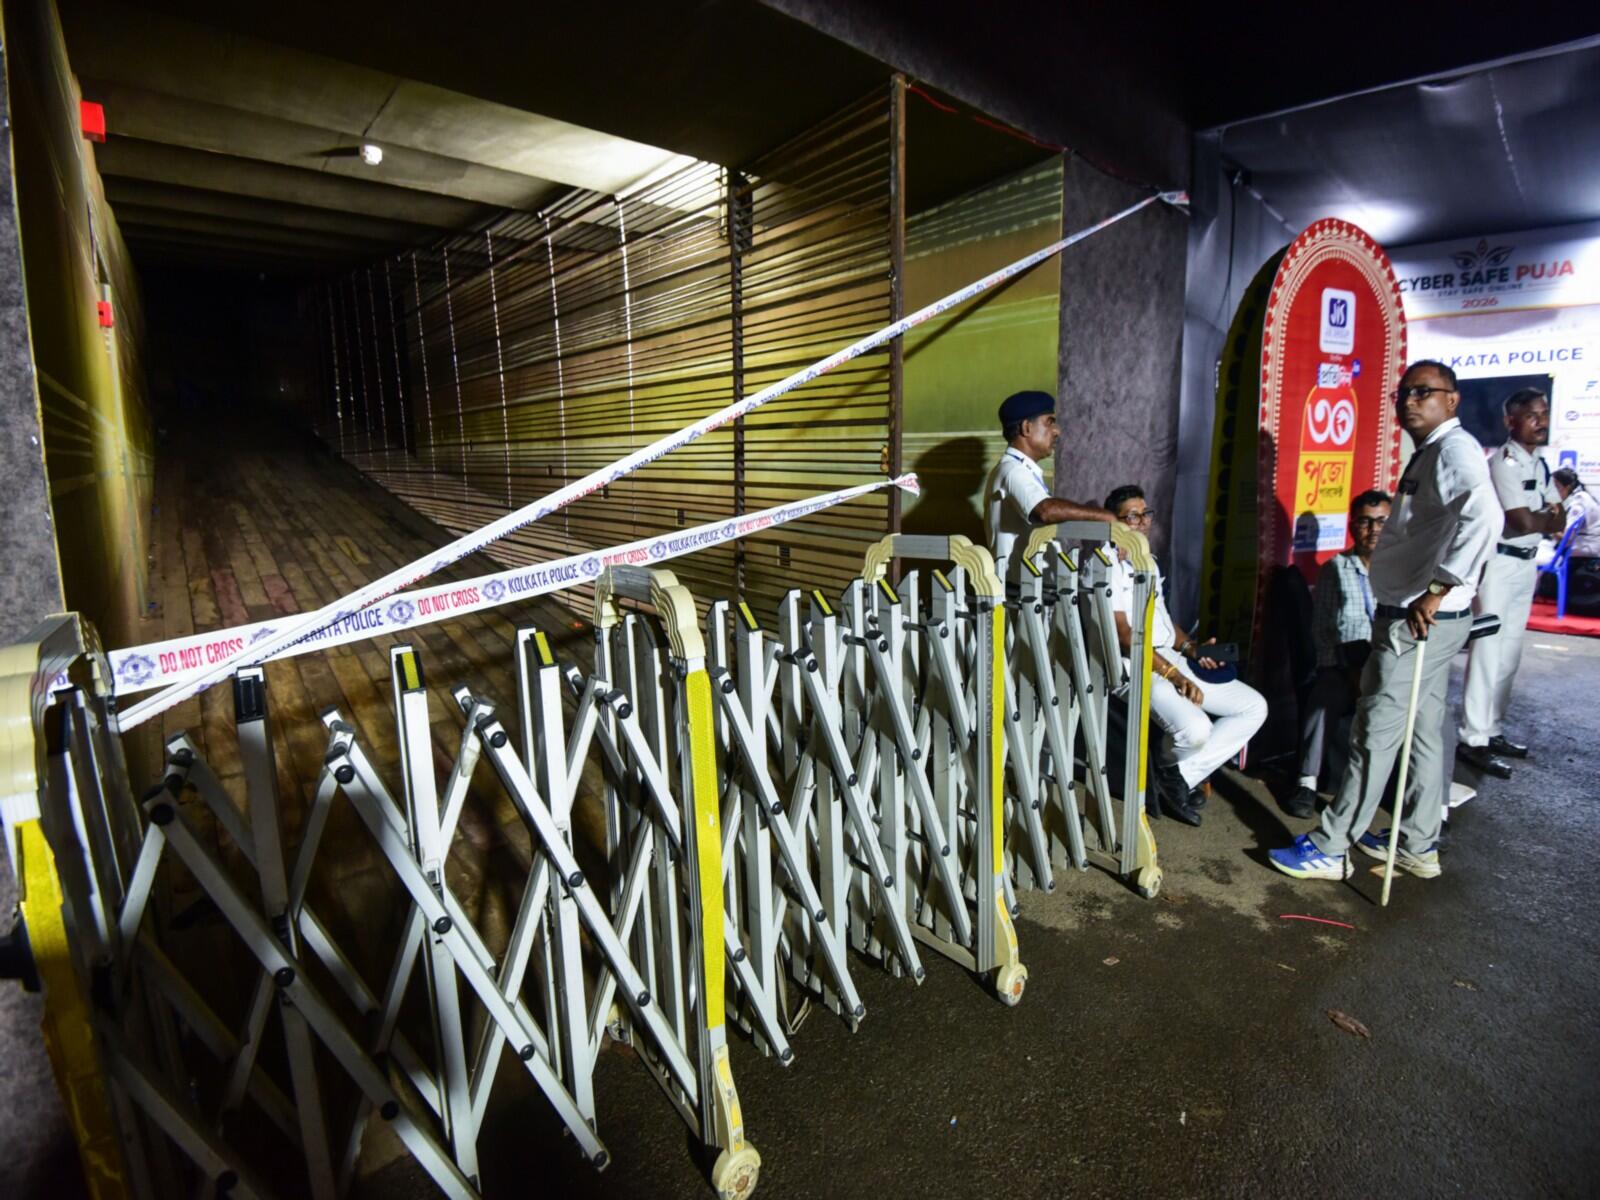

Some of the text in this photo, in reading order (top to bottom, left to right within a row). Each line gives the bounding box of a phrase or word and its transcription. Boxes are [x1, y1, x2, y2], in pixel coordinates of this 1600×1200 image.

[1397, 260, 1574, 293] CYBER SAFE PUJA
[1438, 283, 1523, 298] STAY SAFE ONLINE
[1508, 347, 1583, 364] POLICE
[668, 528, 720, 553] KOLKATA POLICE
[627, 547, 648, 564] CROSS
[508, 563, 579, 594] KOLKATA POLICE
[418, 598, 431, 616] DO
[432, 592, 450, 612] NOT
[450, 587, 480, 608] CROSS
[344, 608, 384, 633] POLICE
[159, 638, 244, 674] DO NOT CROSS
